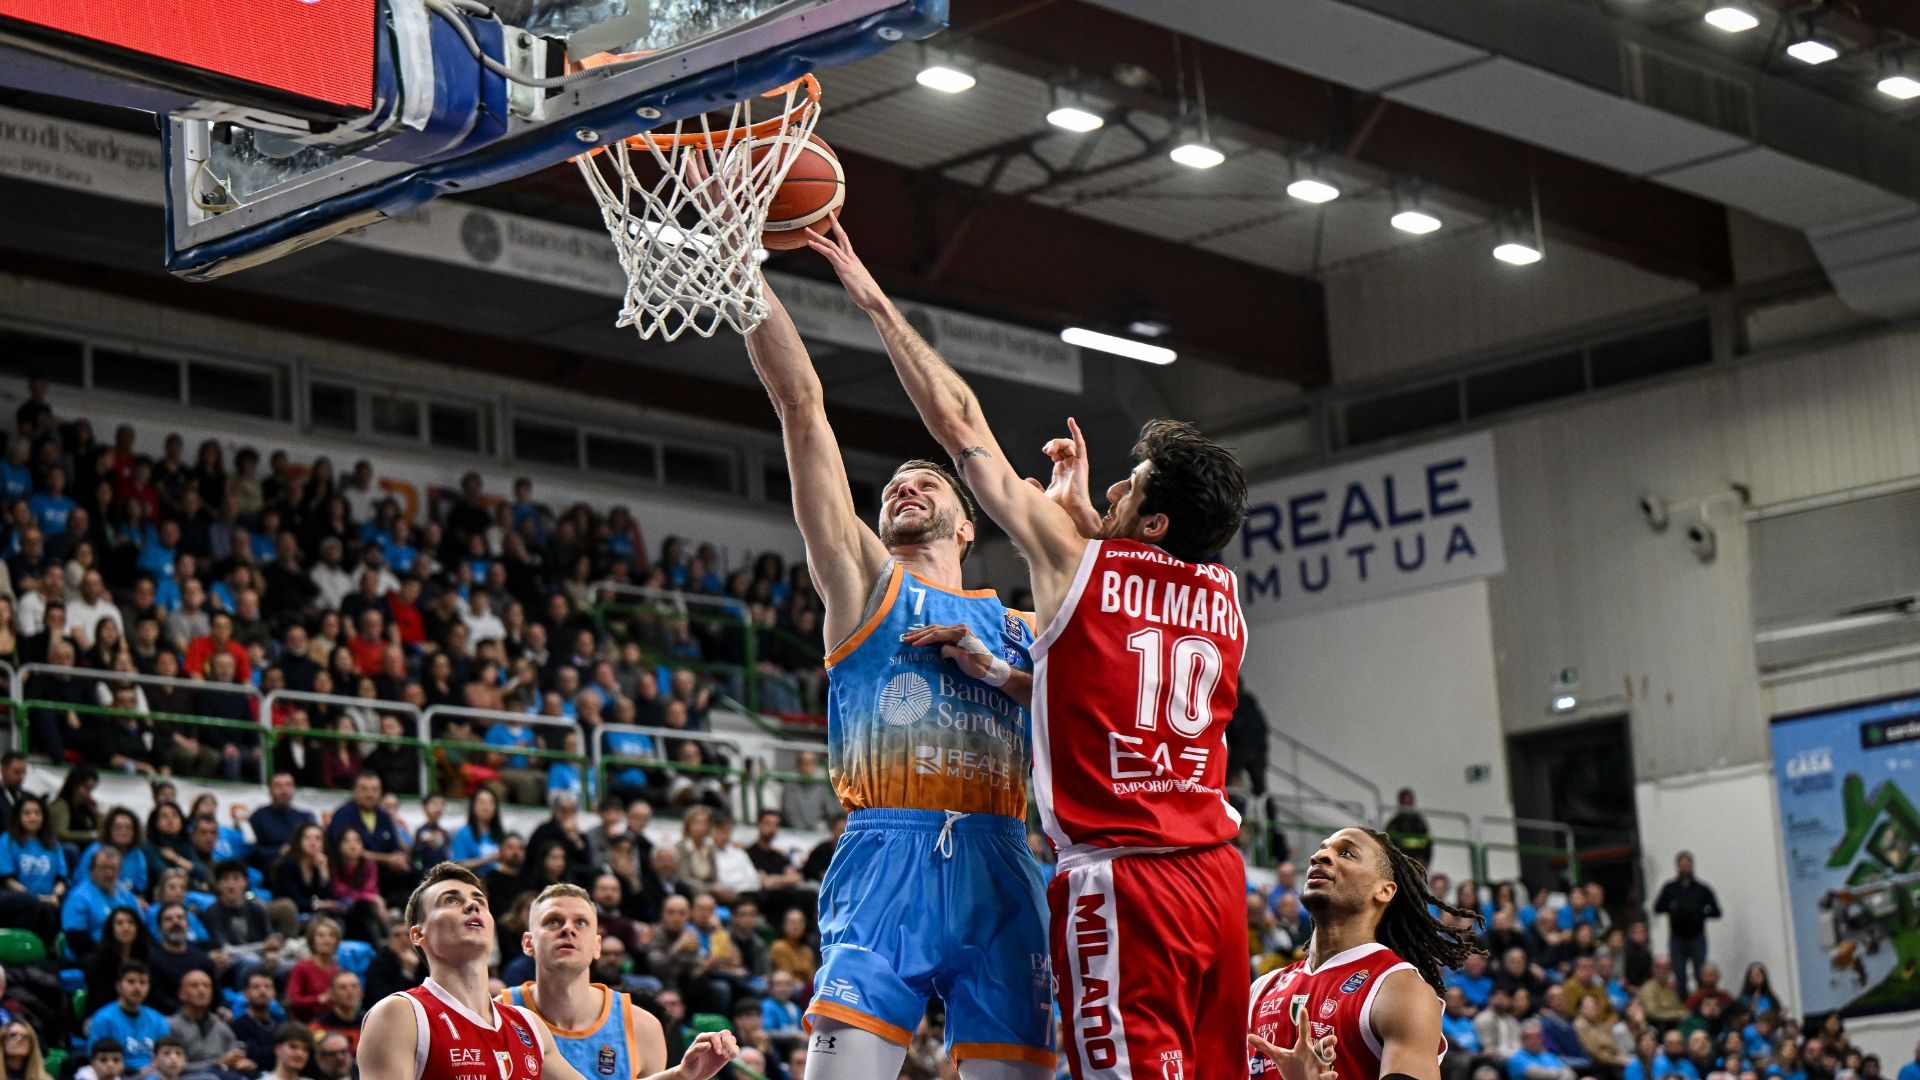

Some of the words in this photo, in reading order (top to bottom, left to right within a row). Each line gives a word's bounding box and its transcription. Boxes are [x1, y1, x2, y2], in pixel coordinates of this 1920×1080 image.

[1242, 456, 1473, 560] REALE
[1105, 550, 1186, 569] DRIVALIA
[1194, 563, 1230, 591] AON
[1245, 523, 1478, 604] MUTUA
[909, 586, 927, 616] 7
[937, 673, 1009, 717] Banco
[1126, 626, 1223, 739] 10
[936, 701, 1026, 755] Sardegn
[947, 747, 1010, 779] REALE
[1109, 731, 1210, 783] EA7
[946, 765, 1011, 791] MUTUA
[1112, 779, 1173, 795] EMPORIO
[1260, 996, 1286, 1015] EA7
[439, 1012, 461, 1041] 1
[449, 1048, 480, 1062] EA7
